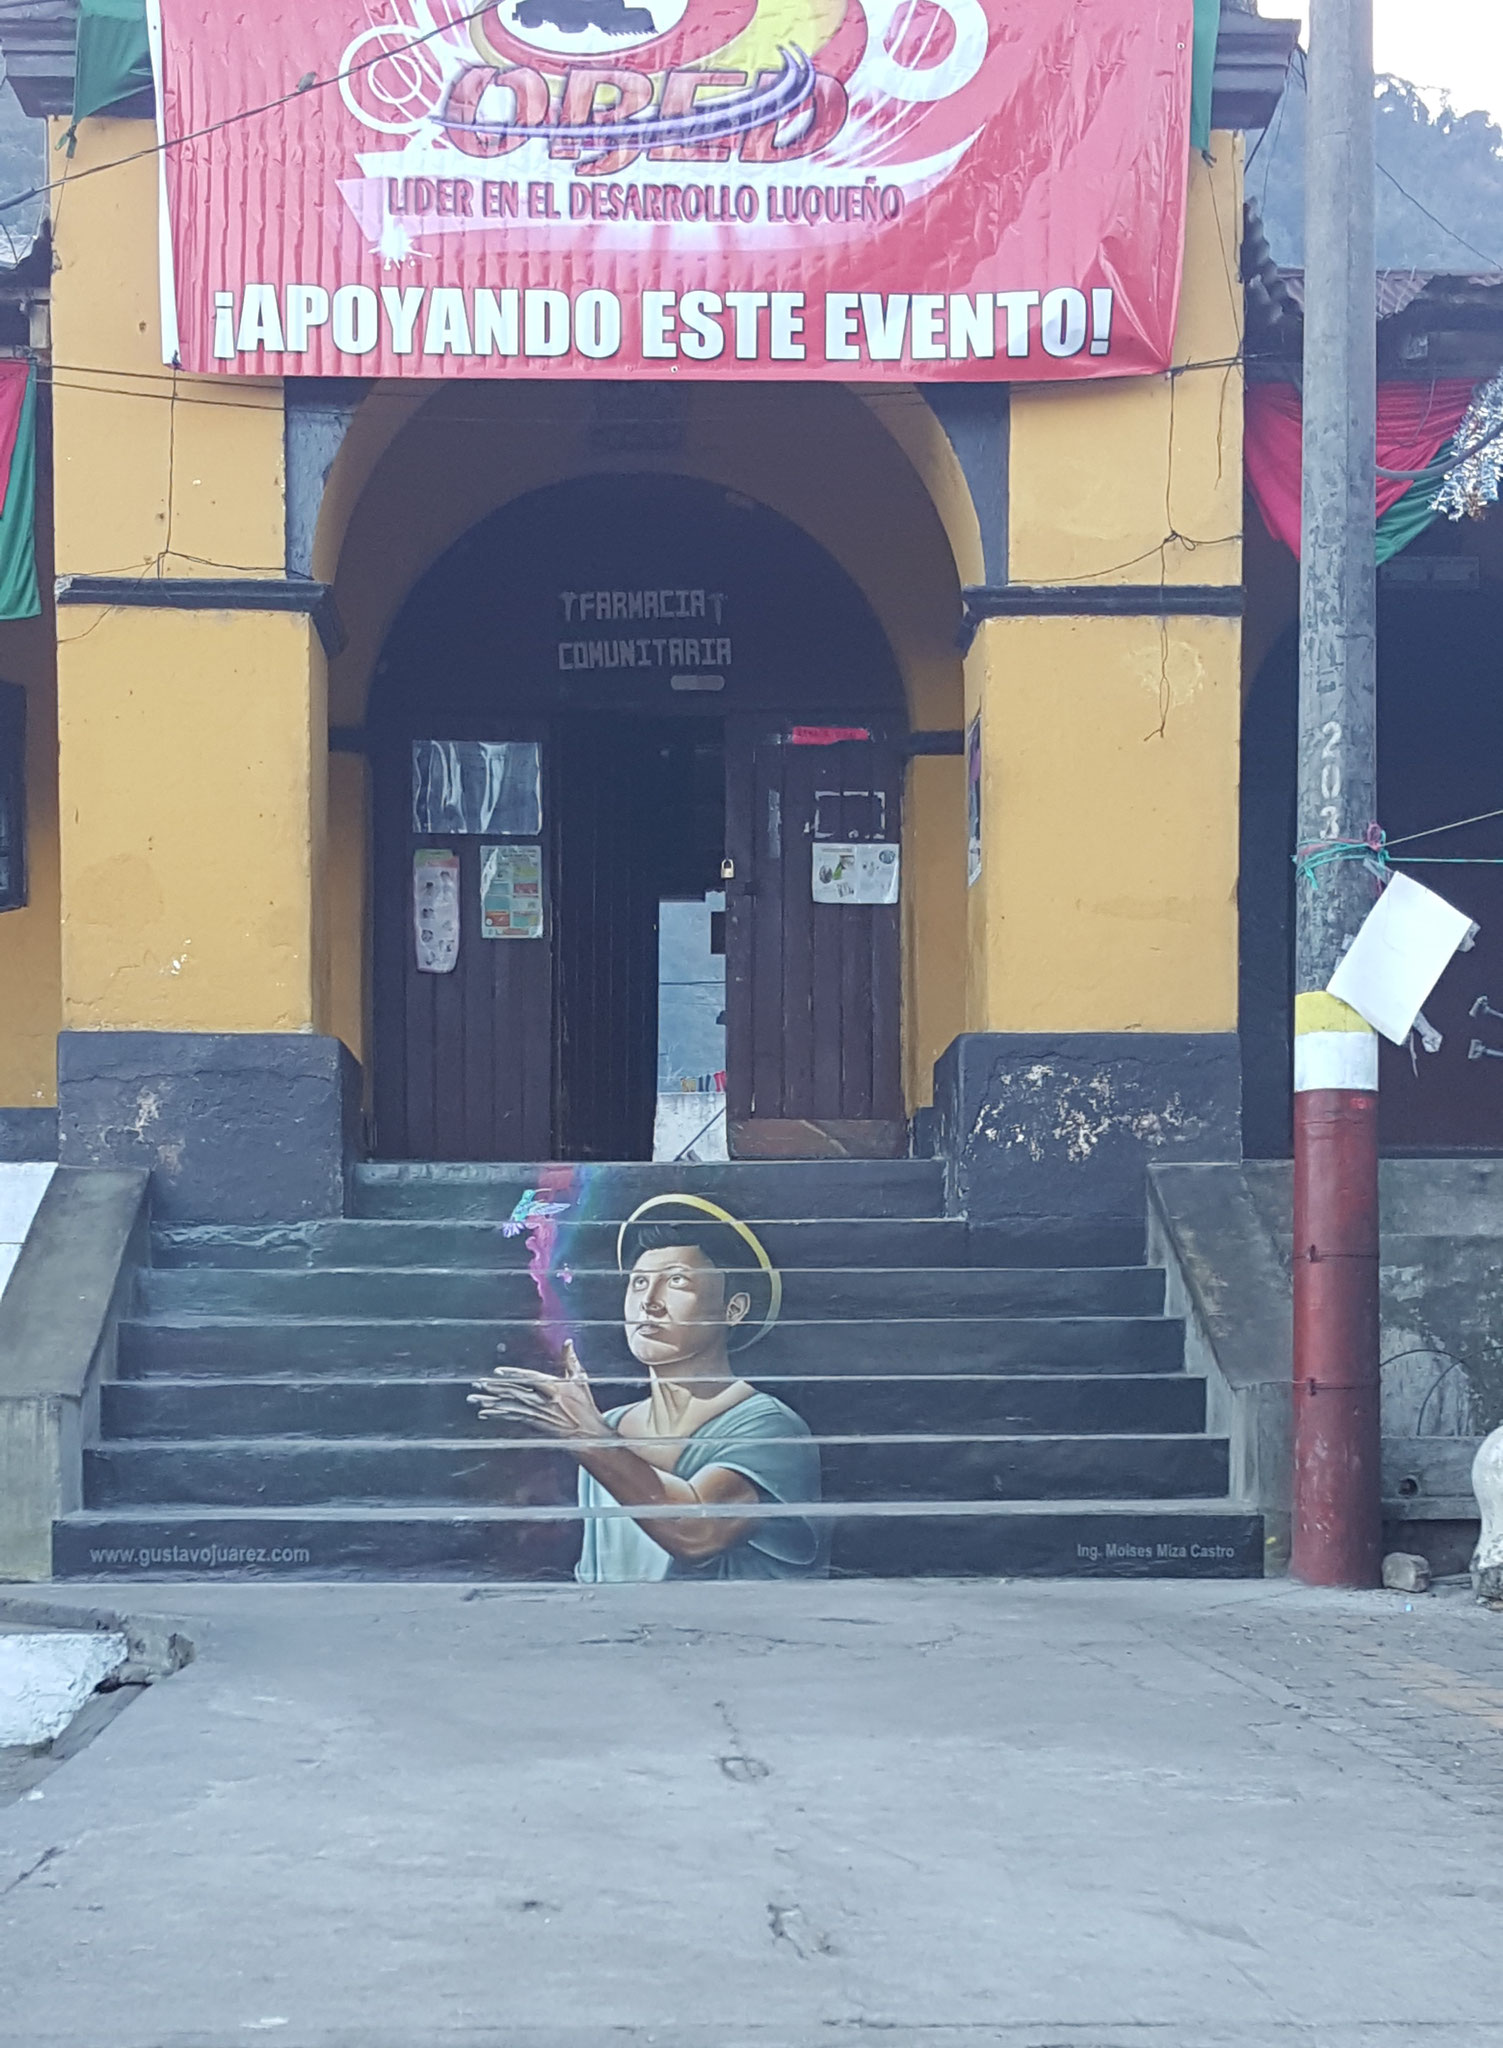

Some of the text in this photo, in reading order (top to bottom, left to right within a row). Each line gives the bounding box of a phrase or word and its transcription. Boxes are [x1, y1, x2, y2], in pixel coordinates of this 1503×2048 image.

[388, 176, 905, 227] LIDER EN EL DESARROLLO LUQUEÑO
[213, 283, 1114, 361] ¡APOYANDO ESTE EVENTO!
[579, 589, 706, 621] FARMACIA
[558, 638, 732, 670] COMUNITARIA
[90, 1544, 310, 1568] www.gustavojuarez.com
[1077, 1543, 1236, 1561] Ing. Moises Miza Castro
